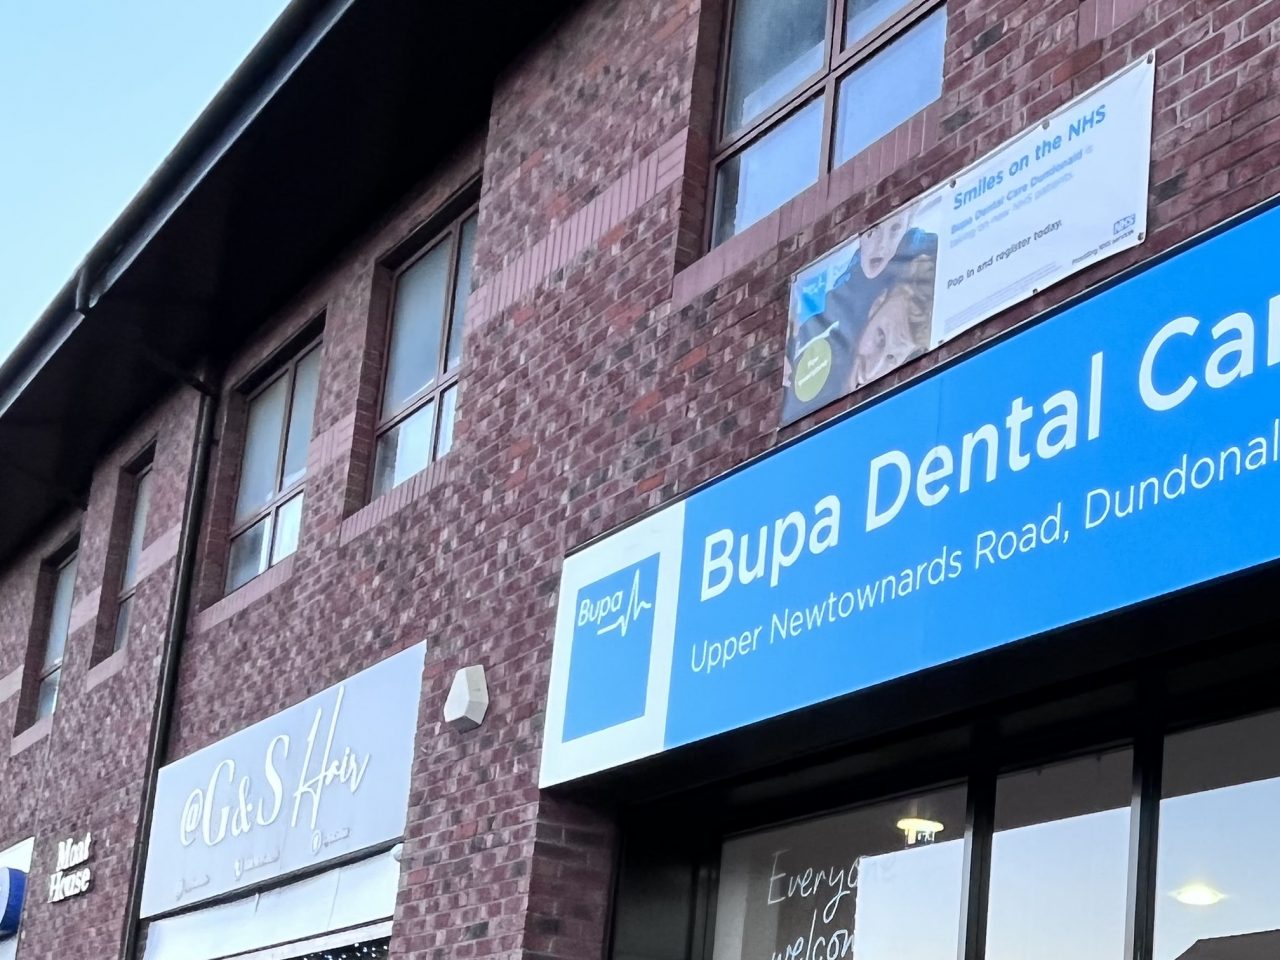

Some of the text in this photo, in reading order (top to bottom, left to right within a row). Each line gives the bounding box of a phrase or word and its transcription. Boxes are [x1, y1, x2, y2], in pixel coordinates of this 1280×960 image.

[953, 104, 1107, 210] Smiles on the NHS
[947, 275, 964, 290] Pop
[966, 267, 975, 280] in
[976, 255, 994, 273] and
[995, 236, 1031, 261] register
[700, 494, 841, 602] Bupa
[865, 352, 1103, 532] Dental
[578, 590, 623, 627] Bupa
[691, 624, 763, 673] Upper
[769, 546, 962, 645] Newtownards
[974, 502, 1069, 570] Road,
[291, 685, 371, 829] Hair
[47, 868, 91, 903] House
